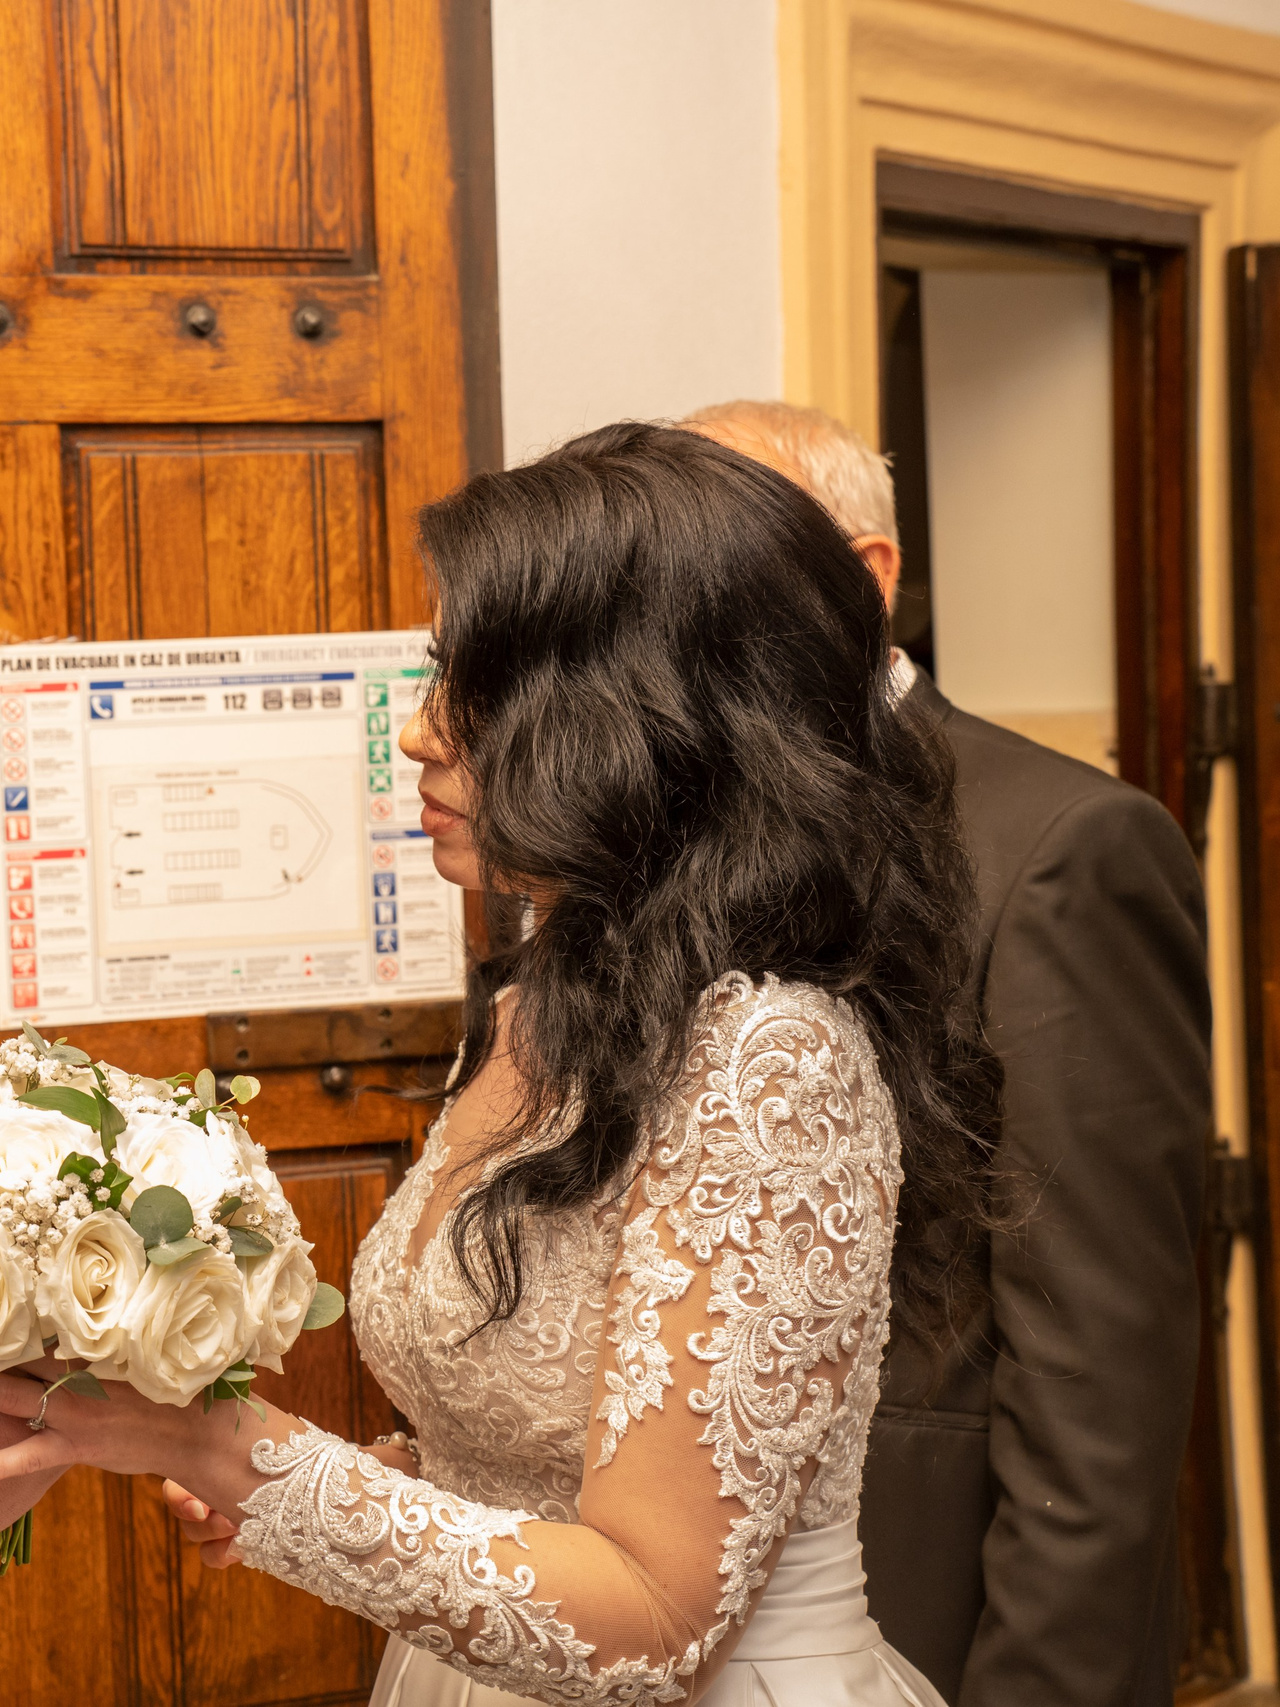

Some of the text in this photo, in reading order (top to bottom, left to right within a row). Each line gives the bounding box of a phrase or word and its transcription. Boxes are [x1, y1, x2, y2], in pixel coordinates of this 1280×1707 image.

[0, 656, 32, 672] PLAN
[36, 656, 51, 671] DE
[56, 654, 119, 670] EVACUARE
[123, 653, 137, 668] IN
[140, 652, 163, 667] CAZ
[167, 651, 181, 666] DE
[185, 650, 241, 665] URGENTA
[222, 693, 248, 711] 112
